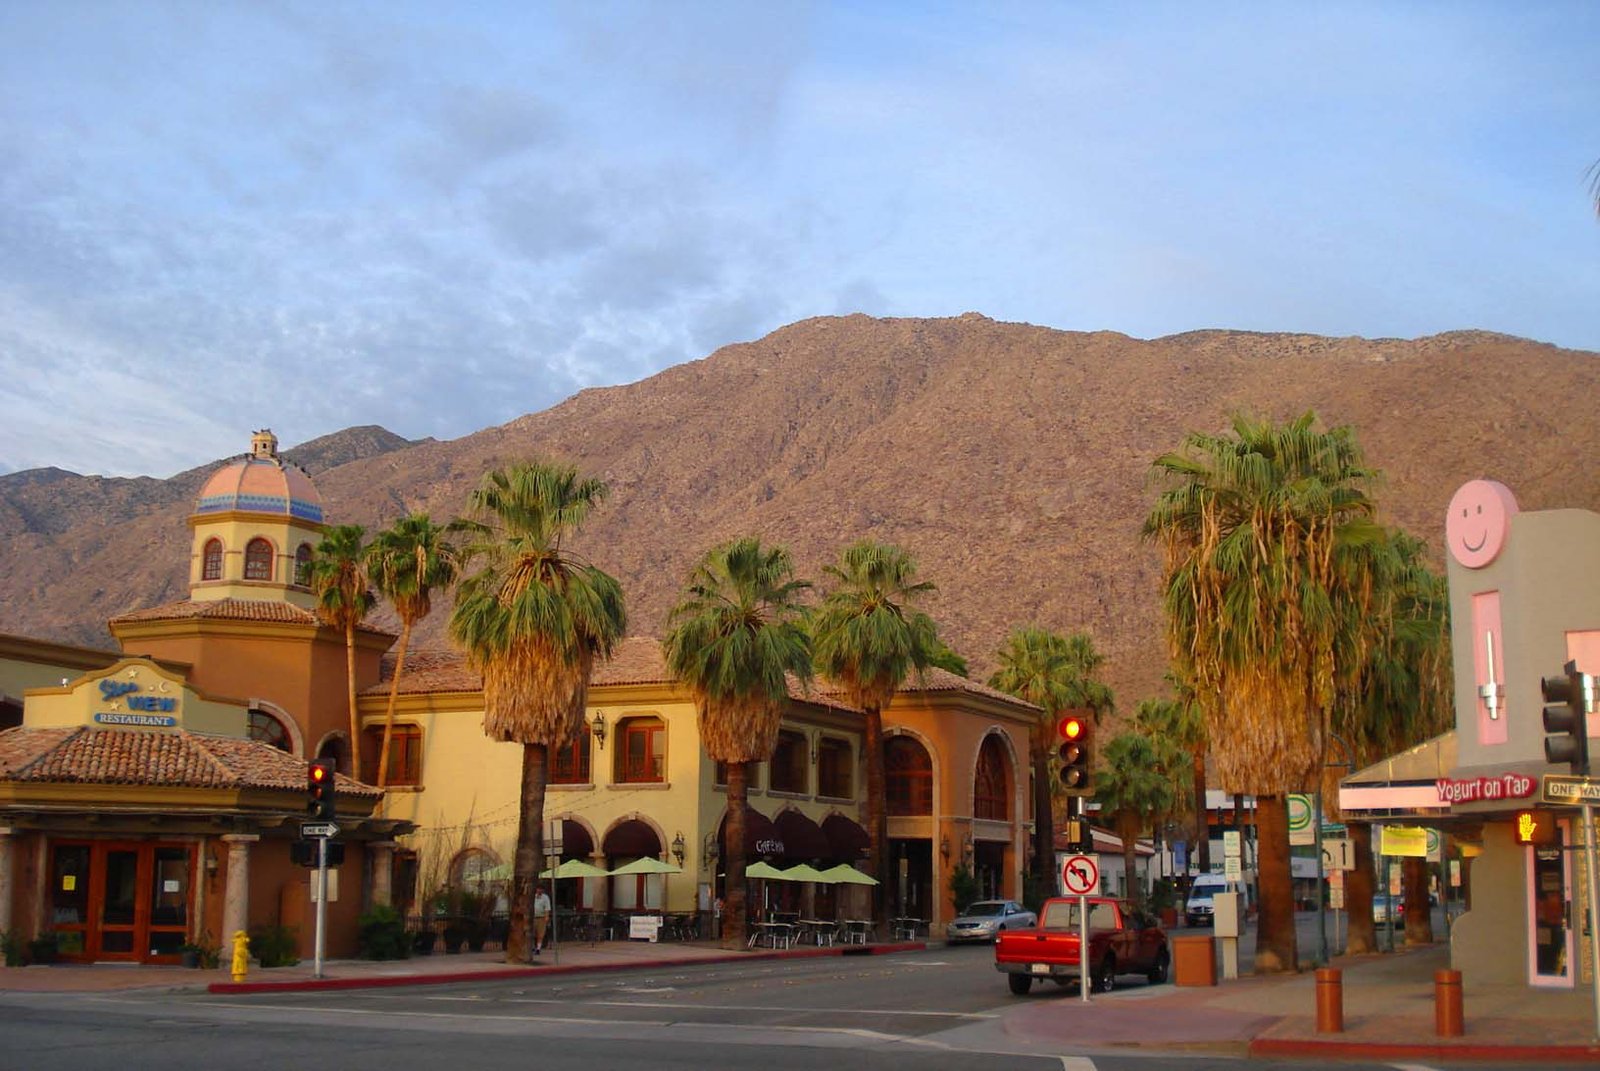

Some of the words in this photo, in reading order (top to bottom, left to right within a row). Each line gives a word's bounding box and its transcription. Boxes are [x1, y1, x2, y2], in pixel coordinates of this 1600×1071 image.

[100, 714, 170, 726] RESTAURANT
[1437, 779, 1481, 801] Yogurt
[1484, 781, 1501, 796] on
[1504, 775, 1530, 795] Tap
[1552, 784, 1574, 796] ONE
